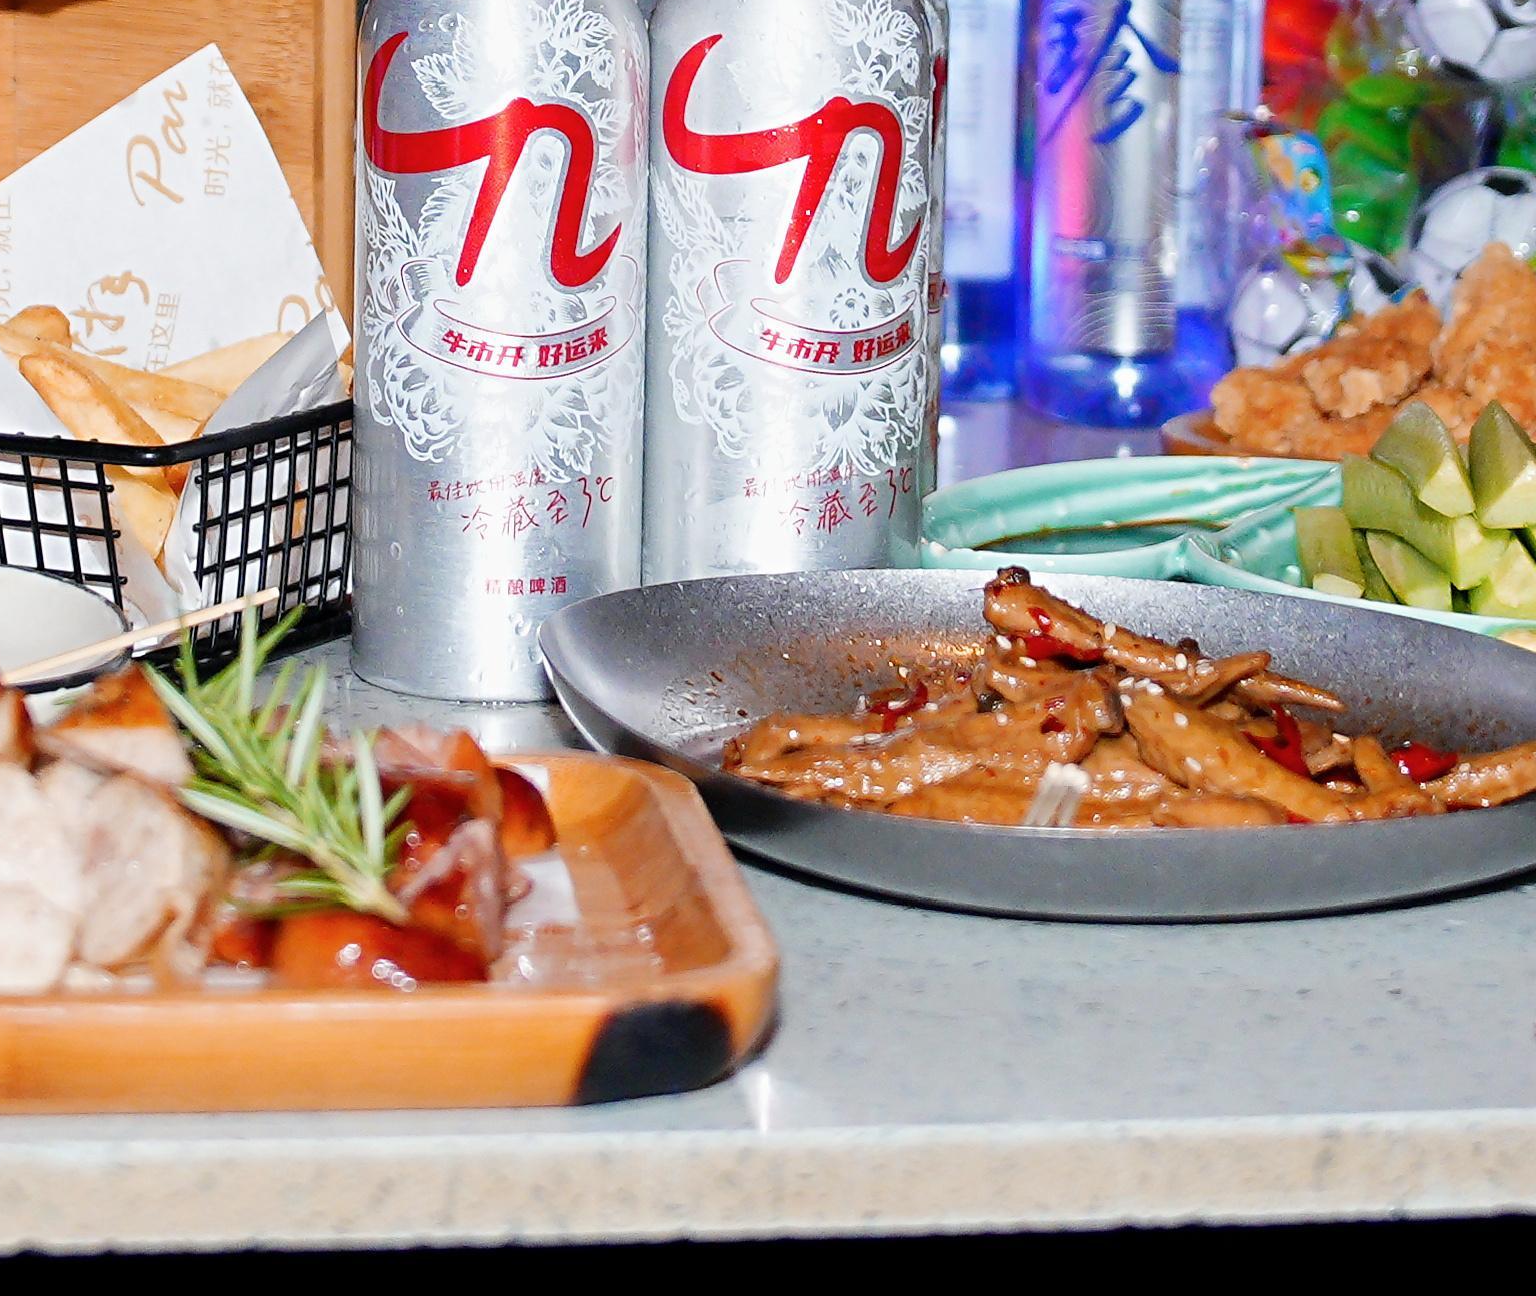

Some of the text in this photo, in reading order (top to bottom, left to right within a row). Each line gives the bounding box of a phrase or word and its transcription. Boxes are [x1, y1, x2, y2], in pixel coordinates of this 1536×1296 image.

[441, 327, 609, 369] 牛市开 好运来
[759, 320, 911, 365] 牛市开 好运来
[485, 576, 568, 596] 精酿啤酒
